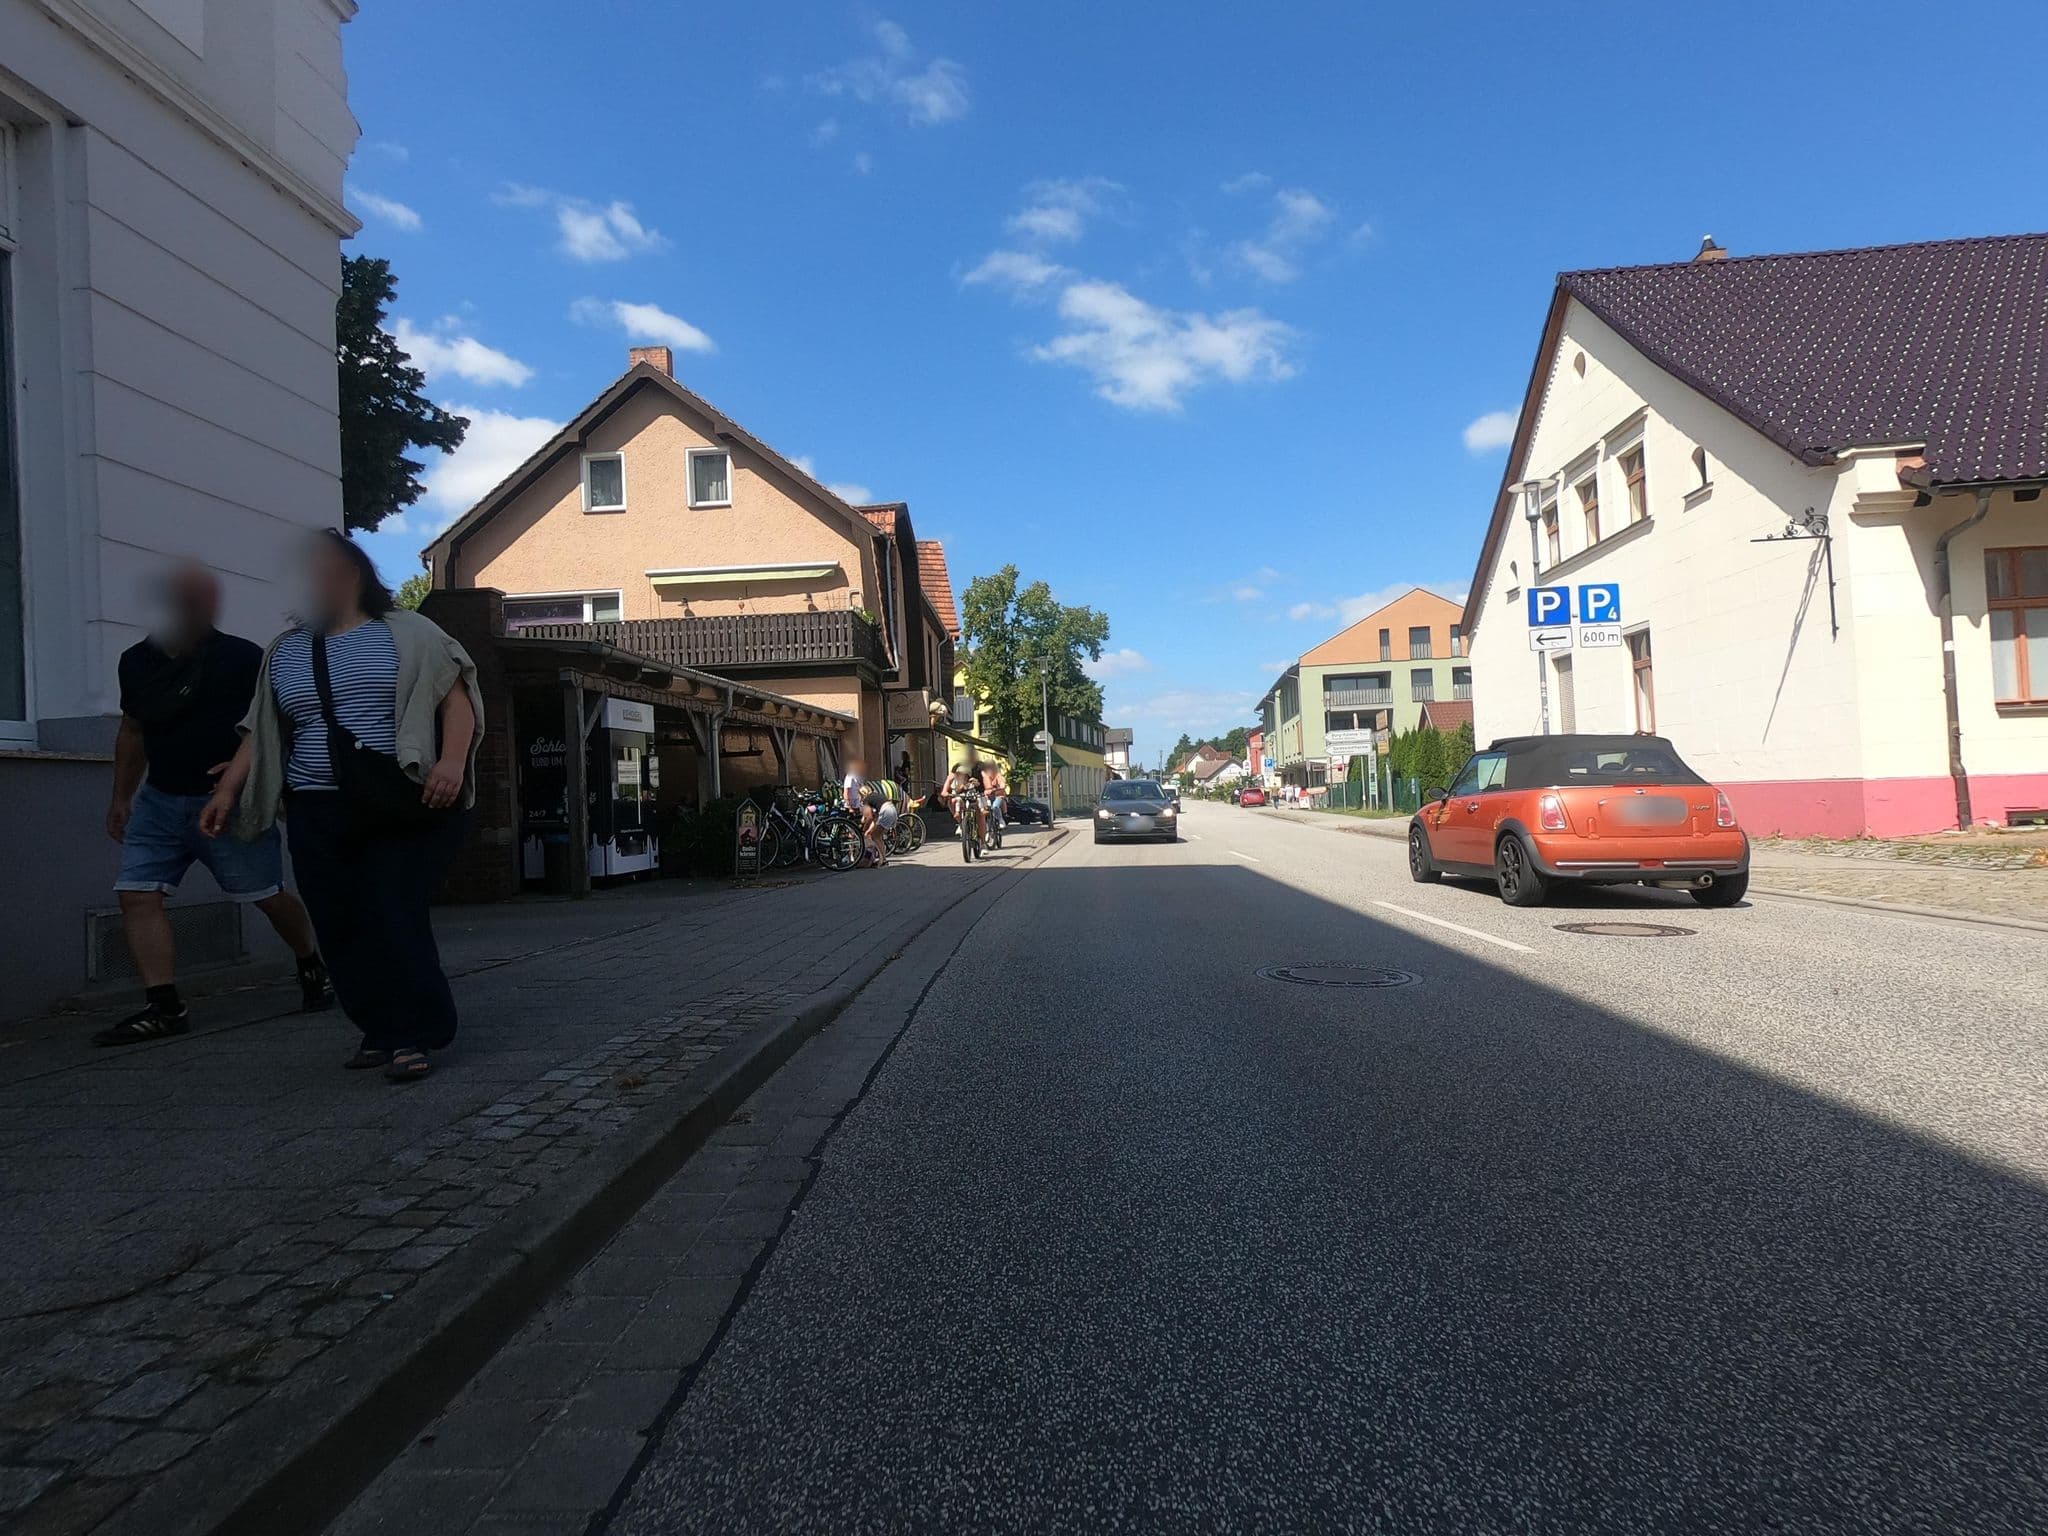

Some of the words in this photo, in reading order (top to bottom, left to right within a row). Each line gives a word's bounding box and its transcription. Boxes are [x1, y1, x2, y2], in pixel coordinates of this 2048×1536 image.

[1536, 591, 1561, 622] P
[1583, 631, 1605, 643] 600
[1607, 632, 1619, 642] m
